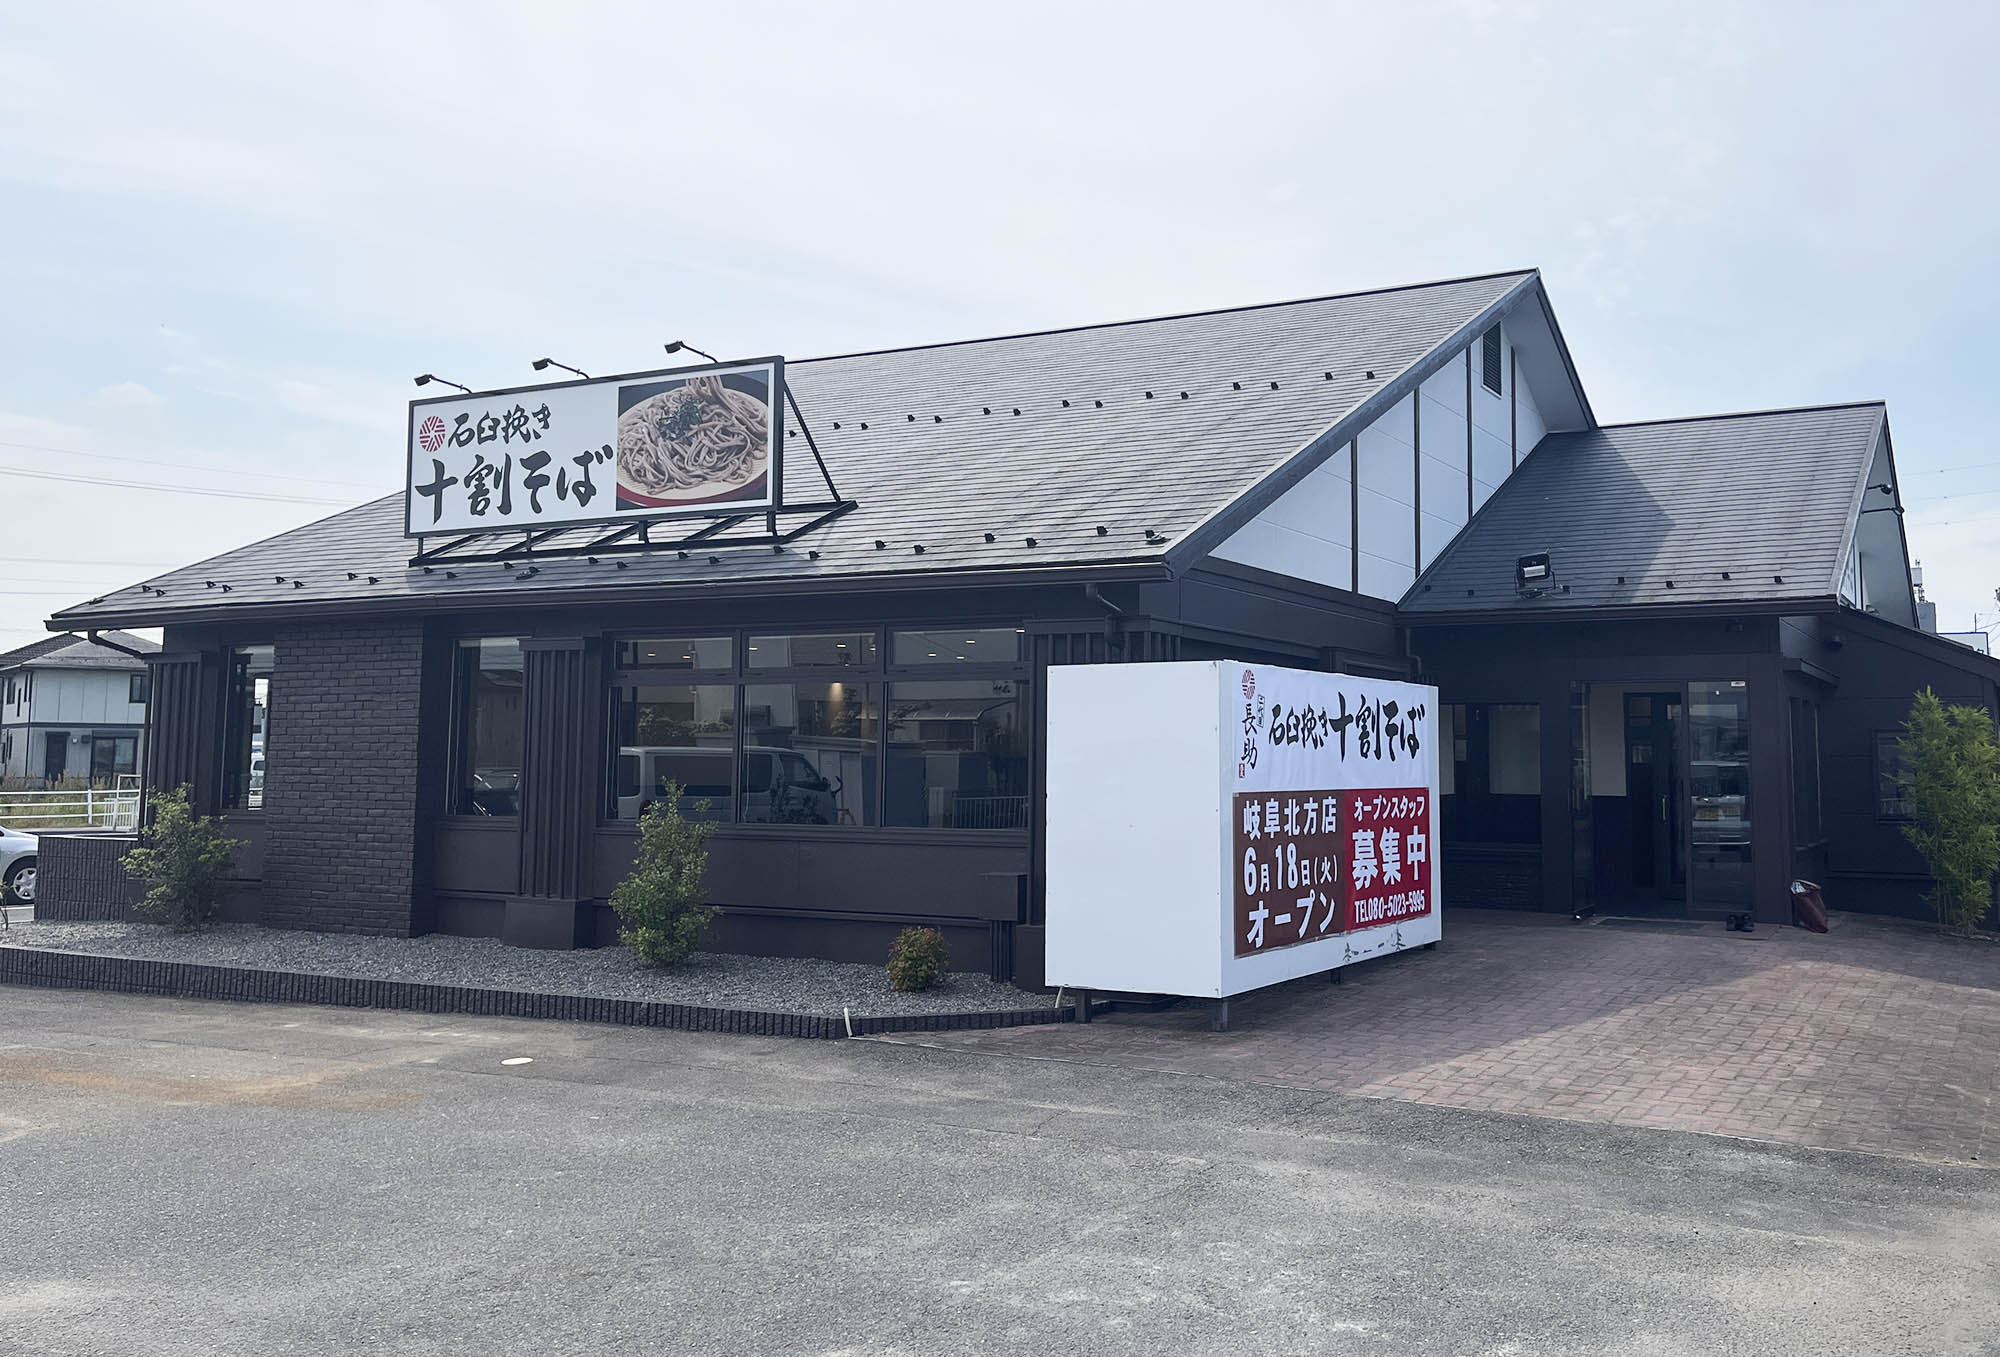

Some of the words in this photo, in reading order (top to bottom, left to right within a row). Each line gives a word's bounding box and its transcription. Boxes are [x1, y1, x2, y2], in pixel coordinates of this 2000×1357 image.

[448, 404, 550, 448] 石臼挽き
[415, 445, 613, 525] 十割そば
[1241, 703, 1258, 770] 長助
[1243, 796, 1337, 840] 岐阜北方店
[1353, 794, 1425, 821] オープンスタッフ
[1352, 825, 1427, 890] 募集中
[1246, 889, 1336, 948] オープン
